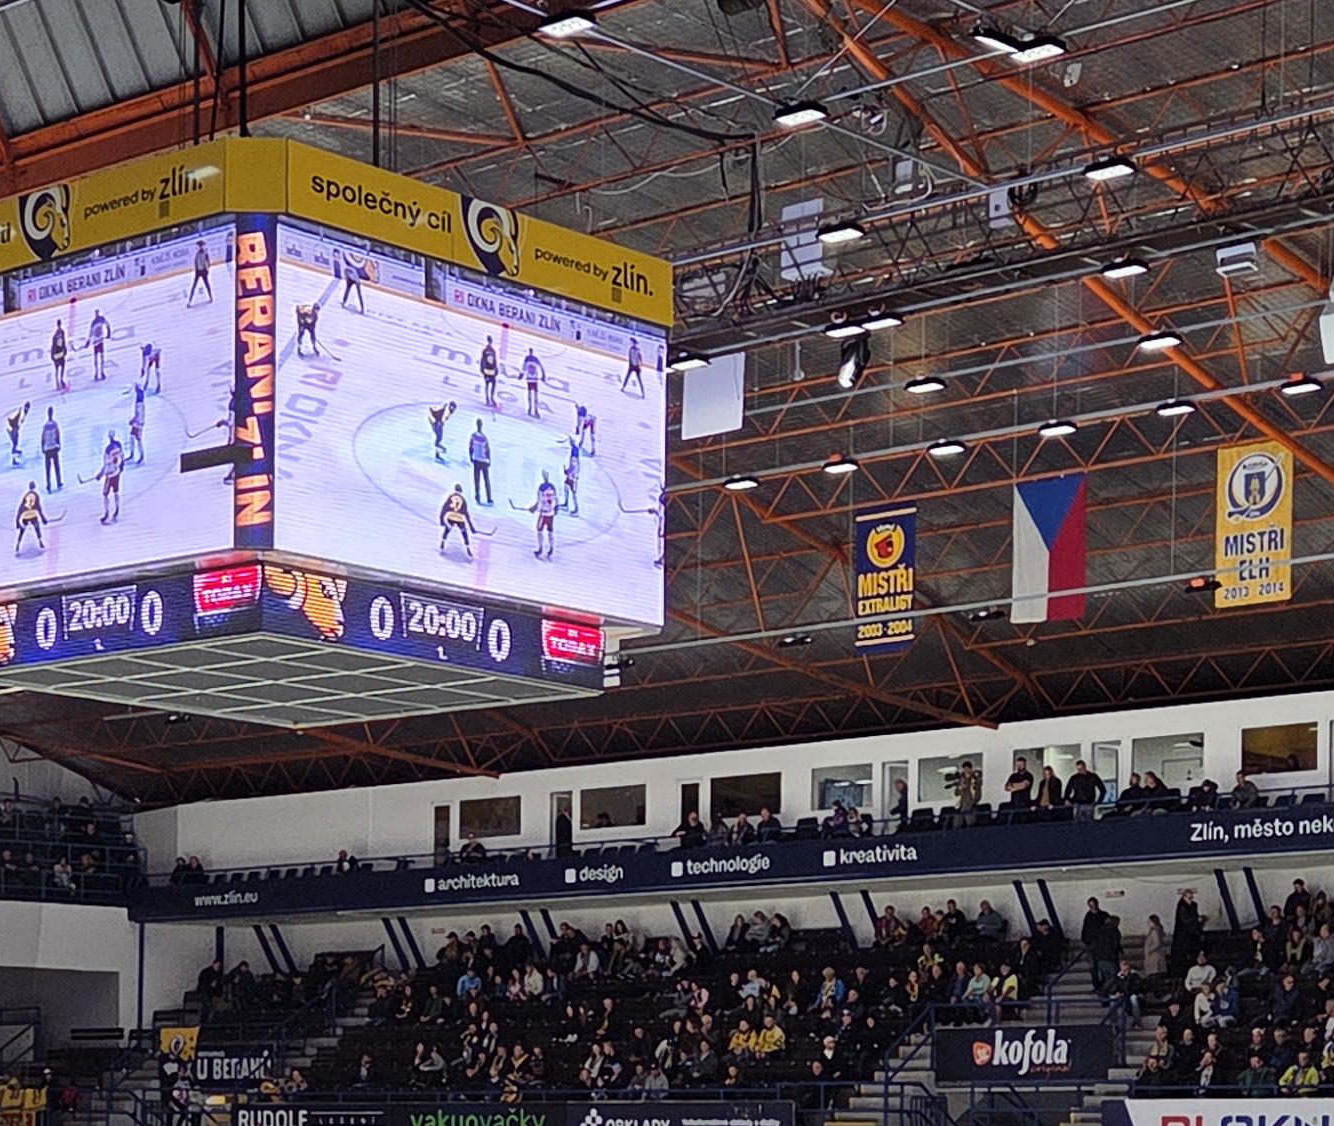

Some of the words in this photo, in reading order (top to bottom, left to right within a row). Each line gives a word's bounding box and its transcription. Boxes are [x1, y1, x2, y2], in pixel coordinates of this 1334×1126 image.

[84, 192, 139, 220] powered
[141, 186, 158, 204] by
[310, 175, 422, 226] společný
[427, 209, 452, 233] cíl
[534, 247, 591, 274] powered
[592, 262, 609, 281] by
[67, 273, 102, 294] BERANI
[103, 265, 126, 287] ZLÍN
[498, 303, 536, 327] BERANI
[538, 310, 561, 333] ZLÍN
[1224, 523, 1285, 558] MISTŘI
[858, 563, 914, 598] MISTŘI
[1239, 557, 1270, 582] ELH
[1259, 582, 1285, 596] 2014
[36, 607, 57, 650] 0
[68, 593, 131, 632] 20:00
[140, 590, 164, 636] 0
[369, 596, 394, 640] 0
[408, 602, 476, 642] 20:00
[487, 619, 511, 662] 0
[1190, 820, 1230, 844] Zlín,
[1233, 814, 1295, 839] město
[686, 852, 772, 878] technologie
[839, 842, 919, 867] kreativita
[437, 872, 520, 892] architektura
[579, 864, 624, 884] design
[992, 1028, 1069, 1076] kofola
